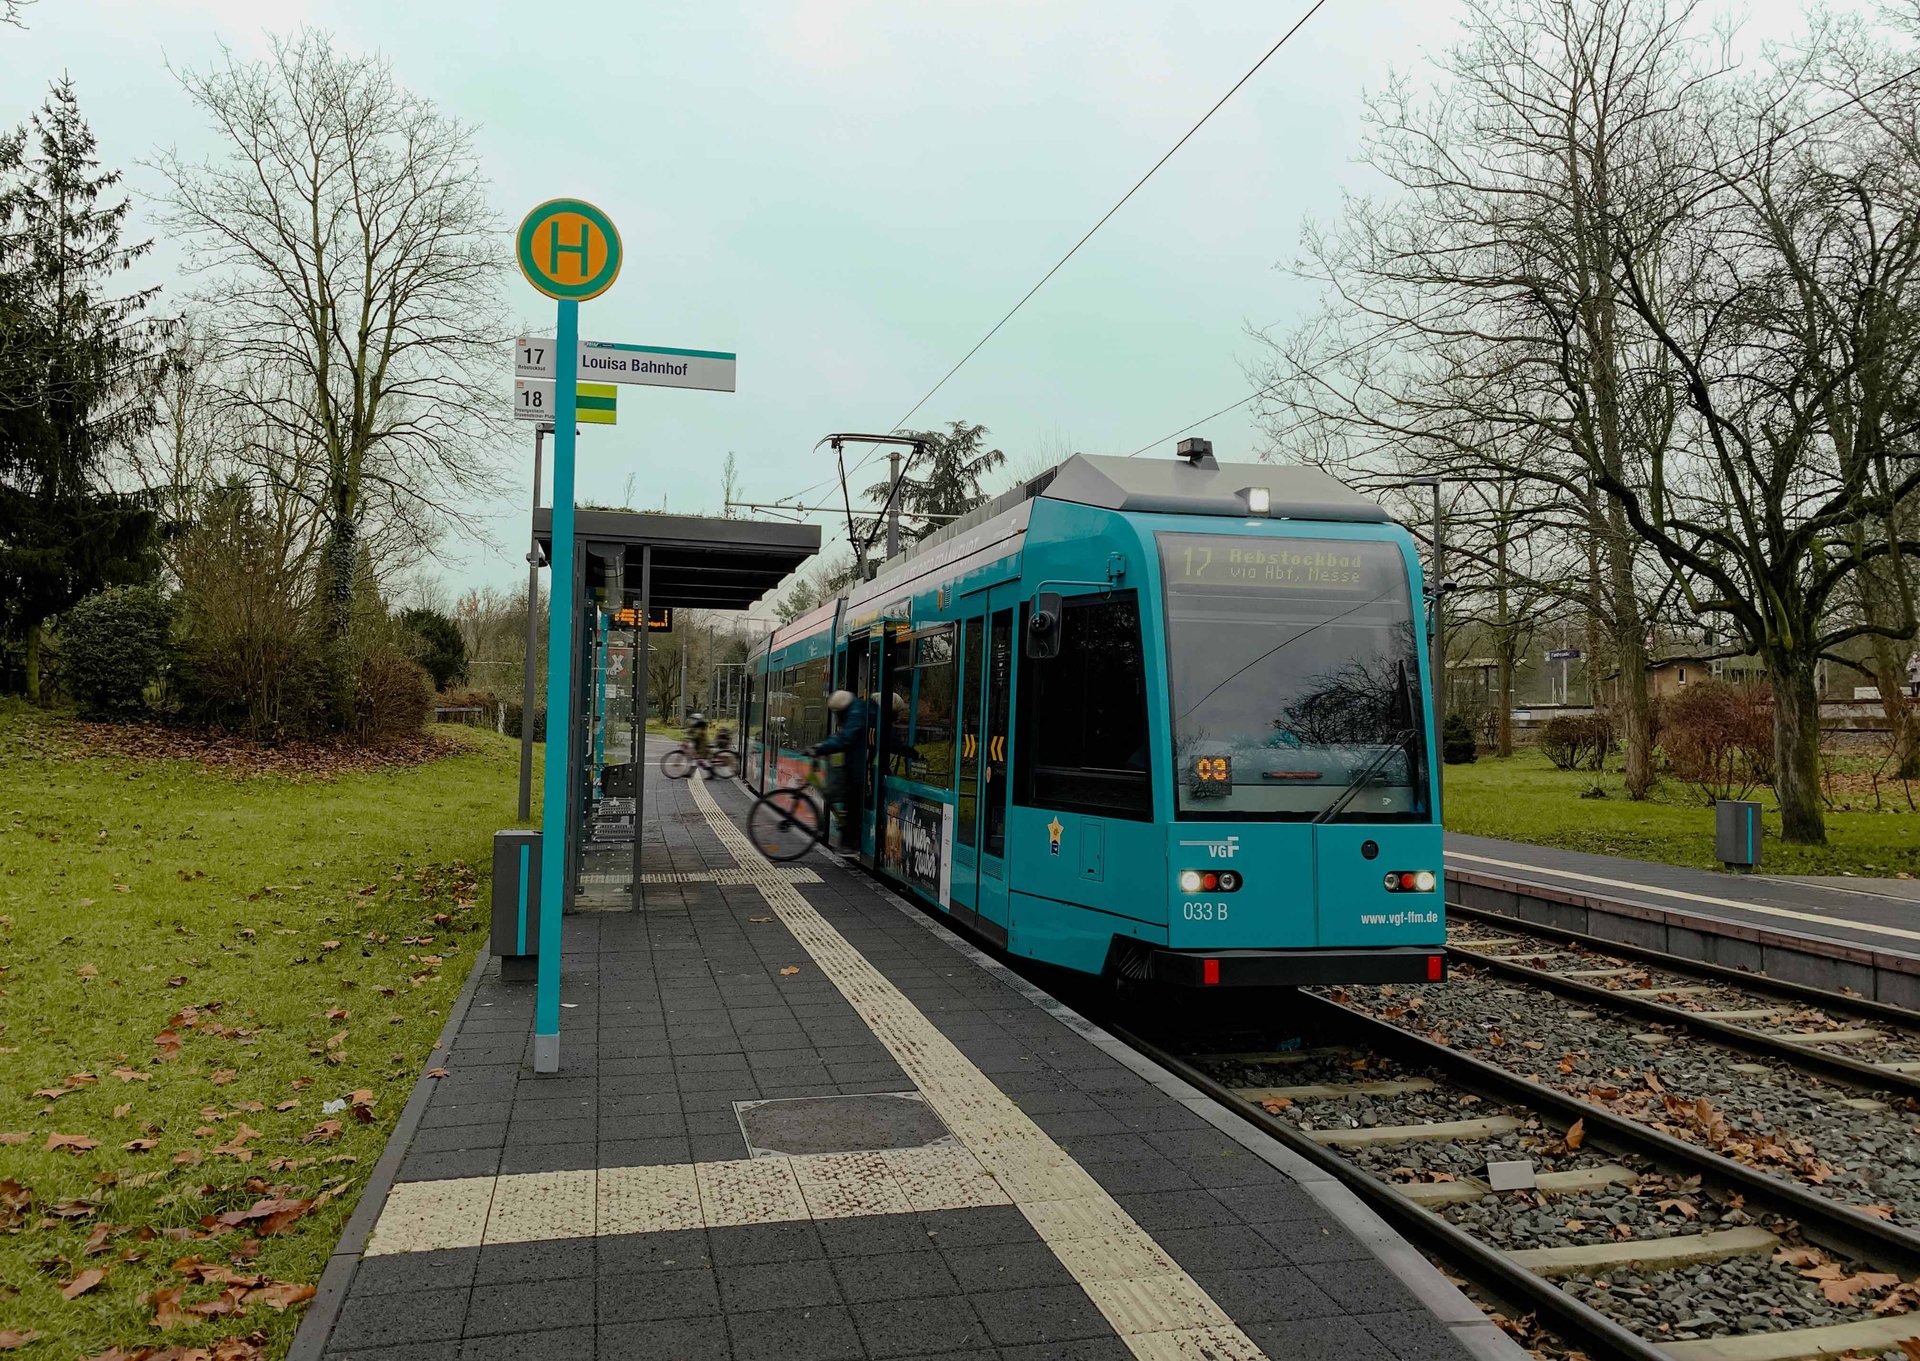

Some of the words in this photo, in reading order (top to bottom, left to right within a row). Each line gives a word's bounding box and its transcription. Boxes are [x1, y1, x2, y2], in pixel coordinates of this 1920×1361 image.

[550, 221, 589, 277] H
[524, 348, 544, 364] 17
[582, 355, 627, 371] Louisa
[631, 358, 688, 376] Bahnhof
[522, 391, 542, 407] 18
[1184, 546, 1211, 576] 17
[1229, 549, 1362, 568] Rebstockbad
[1231, 566, 1256, 579] via
[1308, 568, 1361, 583] Messe
[1208, 836, 1239, 858] VGF
[1184, 902, 1213, 920] 033
[1218, 903, 1228, 920] B
[1361, 911, 1438, 926] www.vgf-ffm.de
